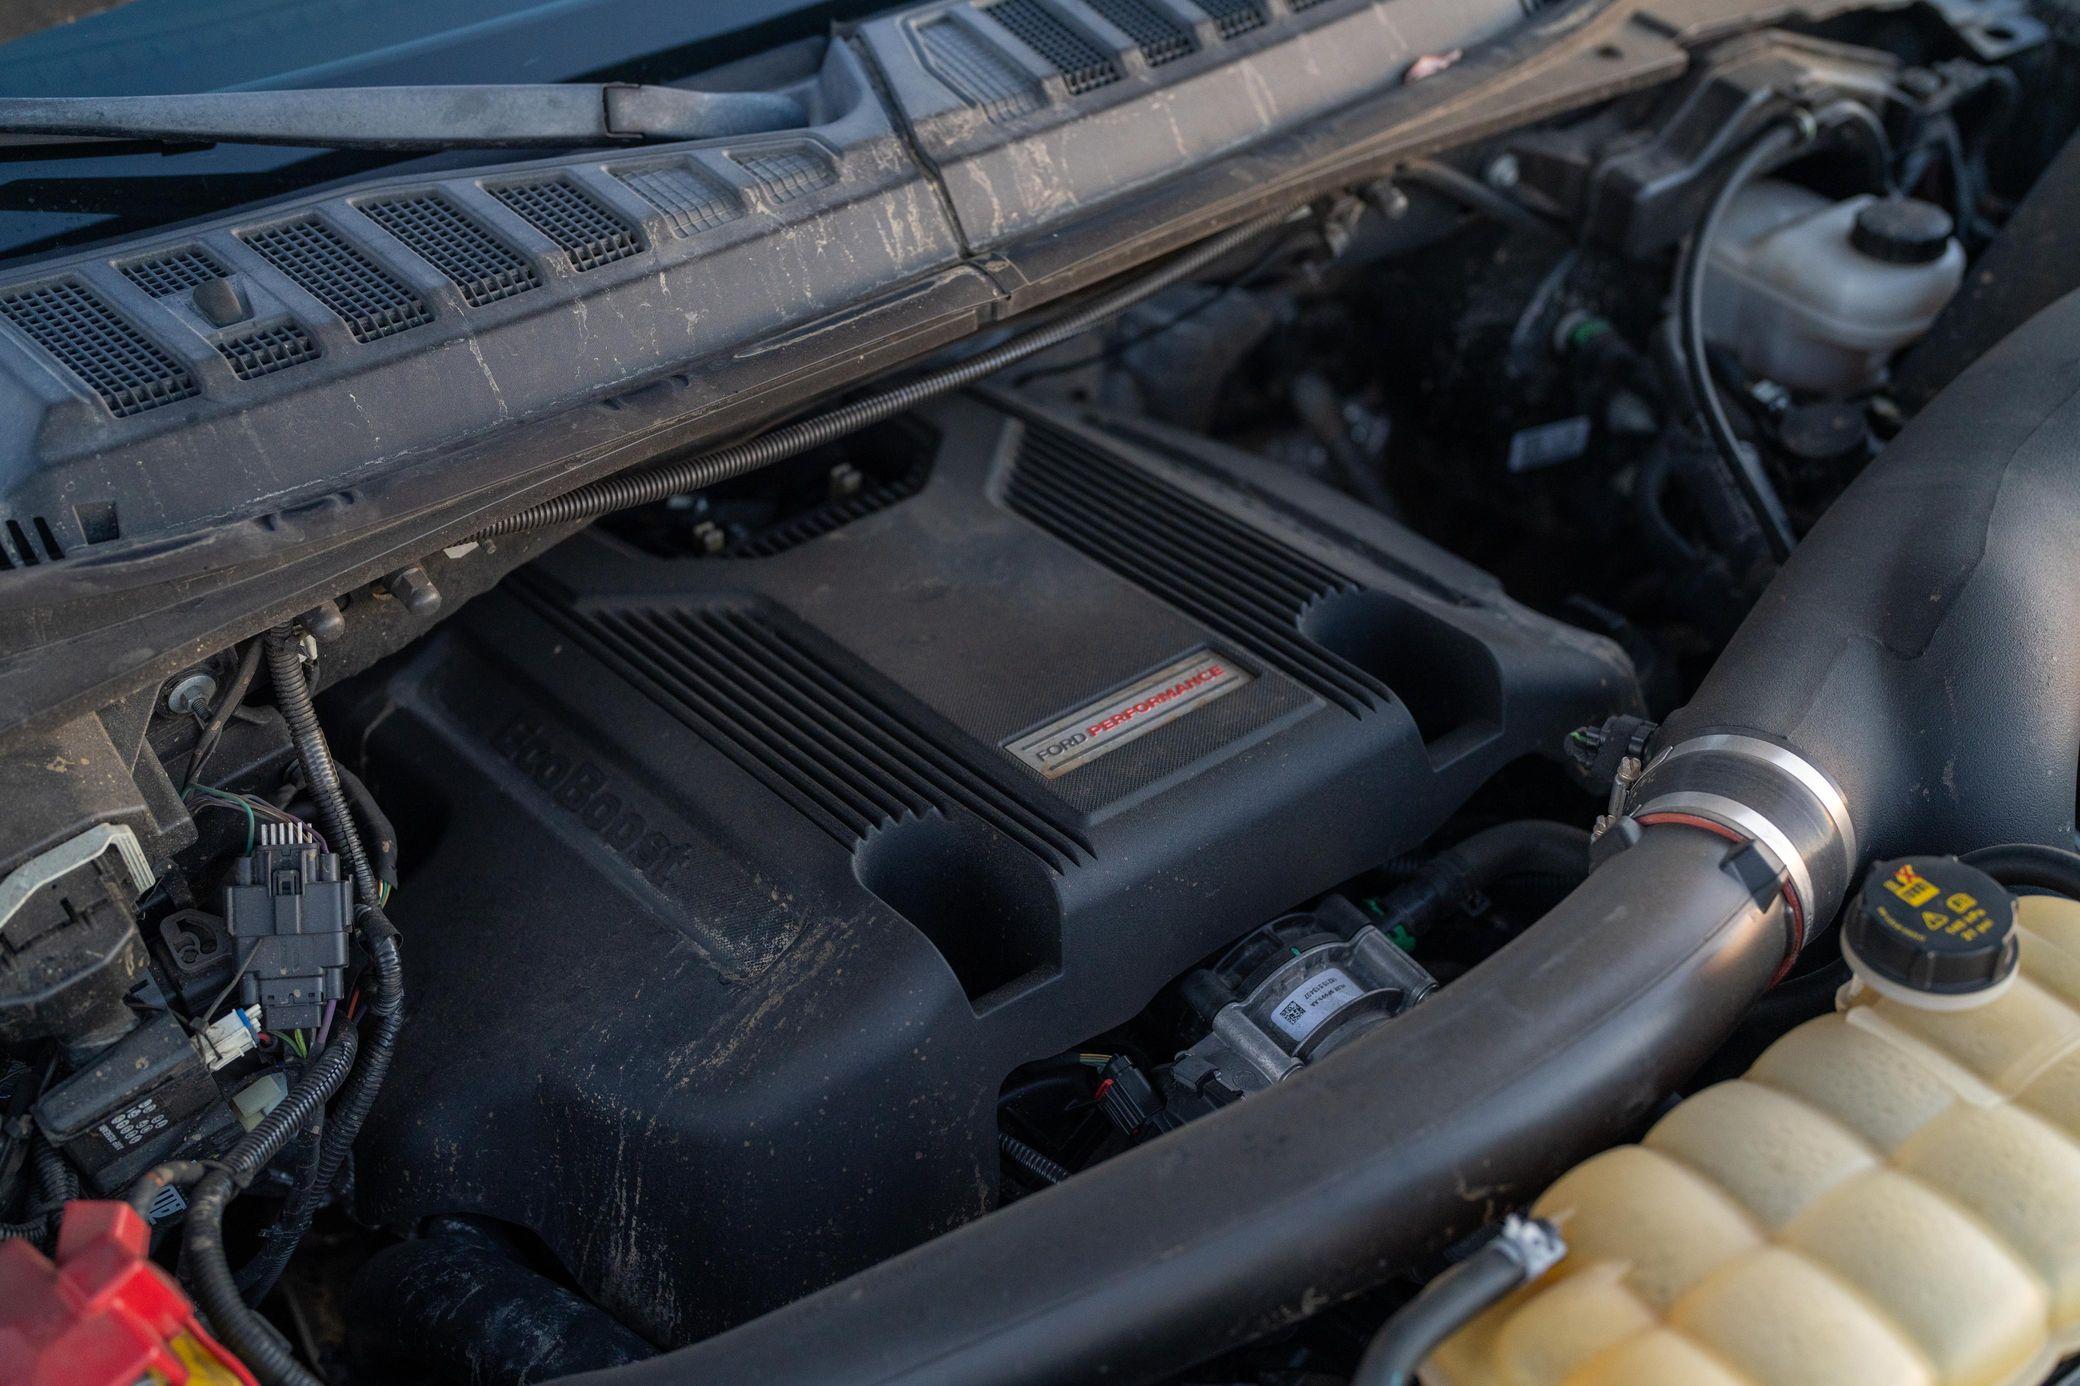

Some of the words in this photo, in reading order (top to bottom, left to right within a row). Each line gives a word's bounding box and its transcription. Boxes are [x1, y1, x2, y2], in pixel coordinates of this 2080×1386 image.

[1035, 731, 1088, 763] FORD
[1086, 663, 1225, 737] PERFORMANCE
[489, 710, 692, 887] EcoBoost
